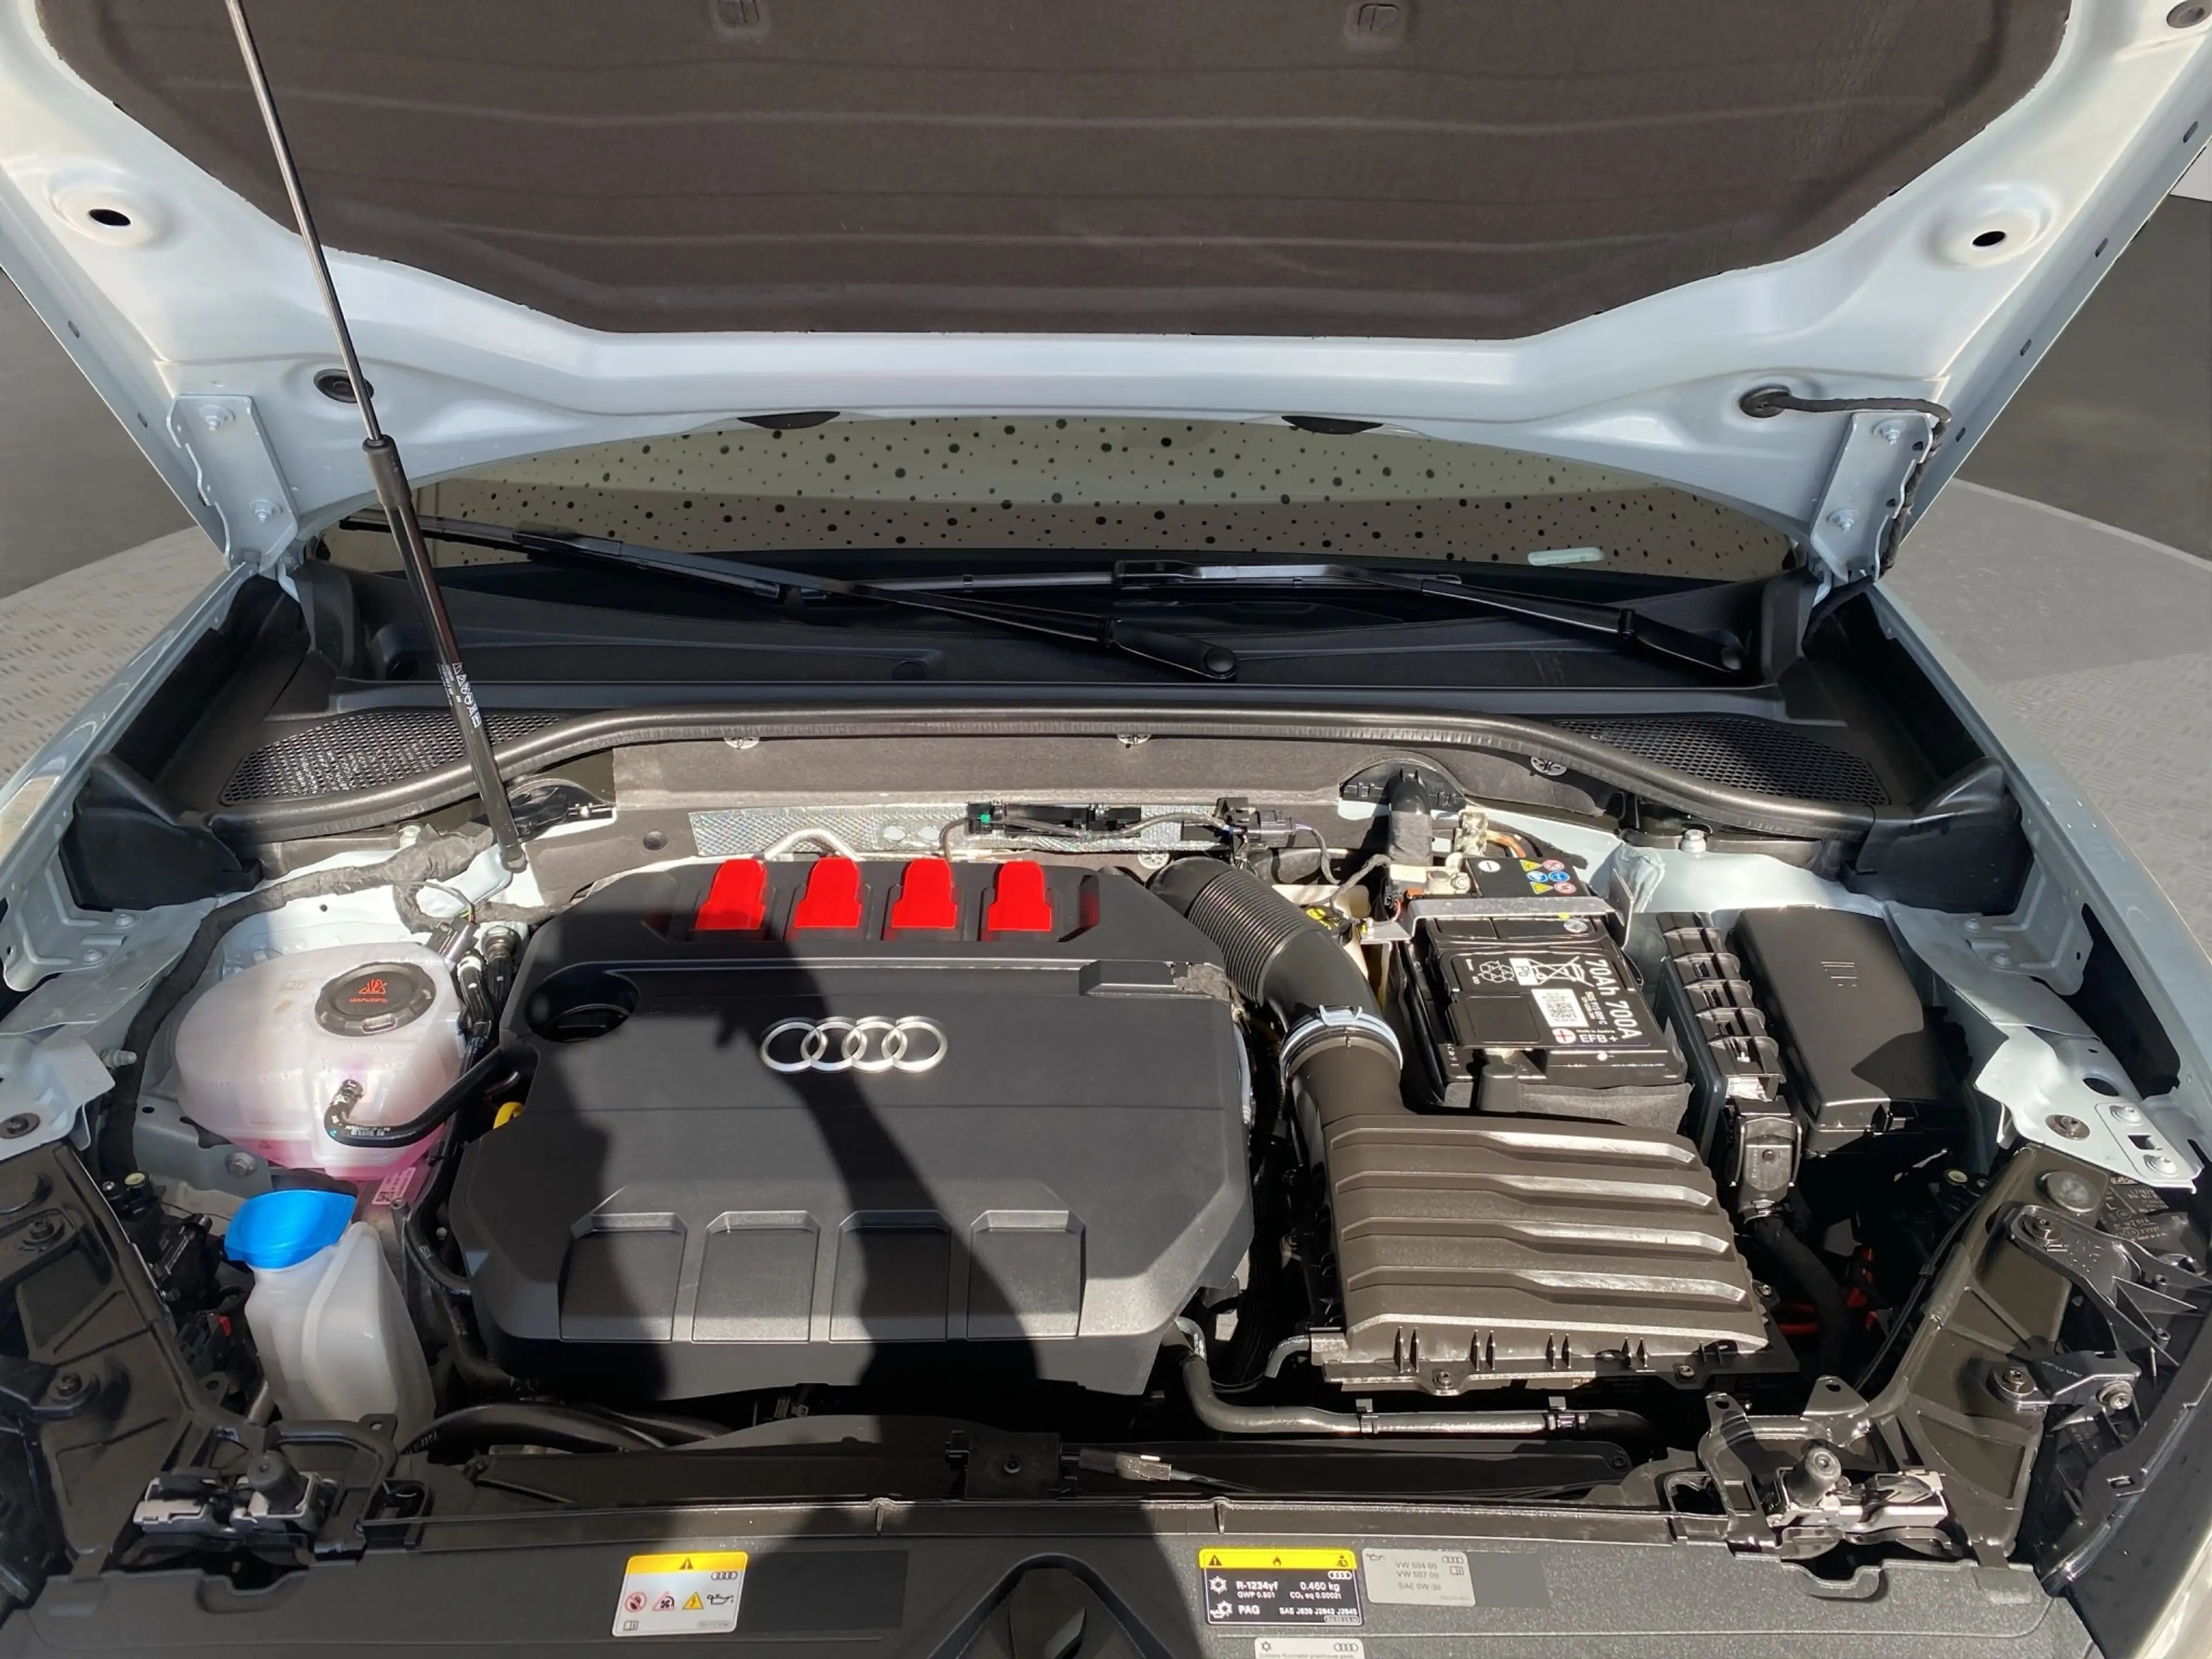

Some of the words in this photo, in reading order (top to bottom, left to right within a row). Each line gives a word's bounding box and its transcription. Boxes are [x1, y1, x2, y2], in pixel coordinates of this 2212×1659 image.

[1585, 959, 1620, 995] 70Ah
[1605, 1000, 1642, 1039] 700A
[1579, 1035, 1608, 1043] EFB
[1396, 1570, 1411, 1578] VW
[1328, 1581, 1340, 1592] kg
[1398, 1582, 1415, 1590] SAE
[1238, 1604, 1260, 1615] PAG
